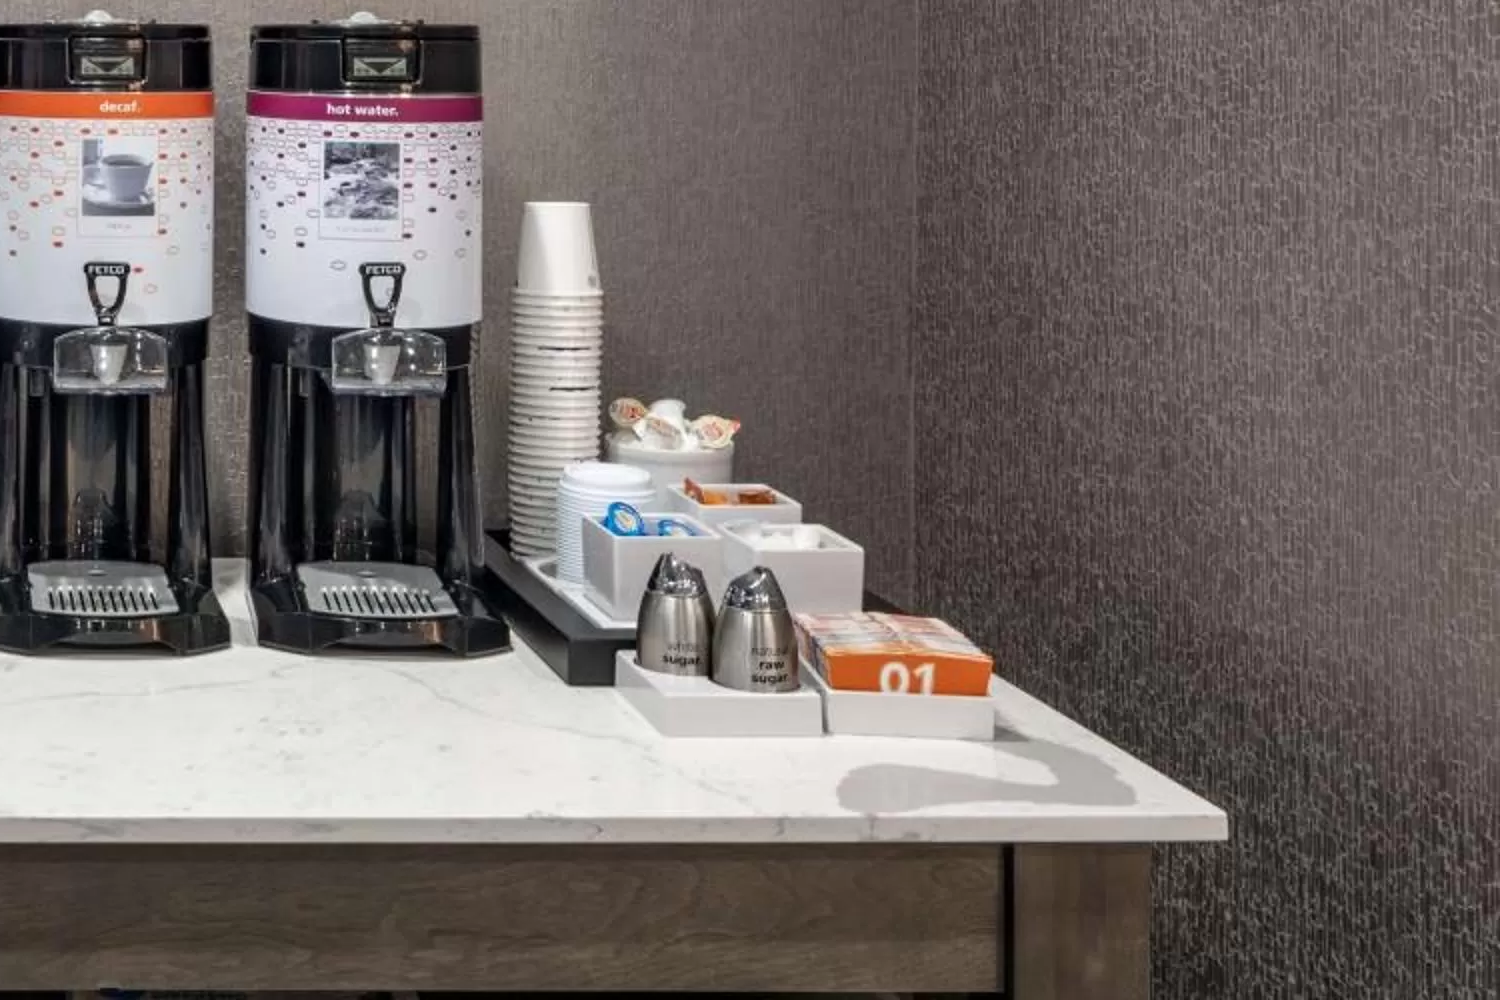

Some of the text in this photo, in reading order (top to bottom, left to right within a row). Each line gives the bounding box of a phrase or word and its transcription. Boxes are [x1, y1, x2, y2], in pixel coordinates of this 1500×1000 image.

[99, 99, 141, 113] decaf.
[326, 102, 399, 117] hot water.
[759, 660, 785, 670] raw
[880, 661, 936, 696] 01
